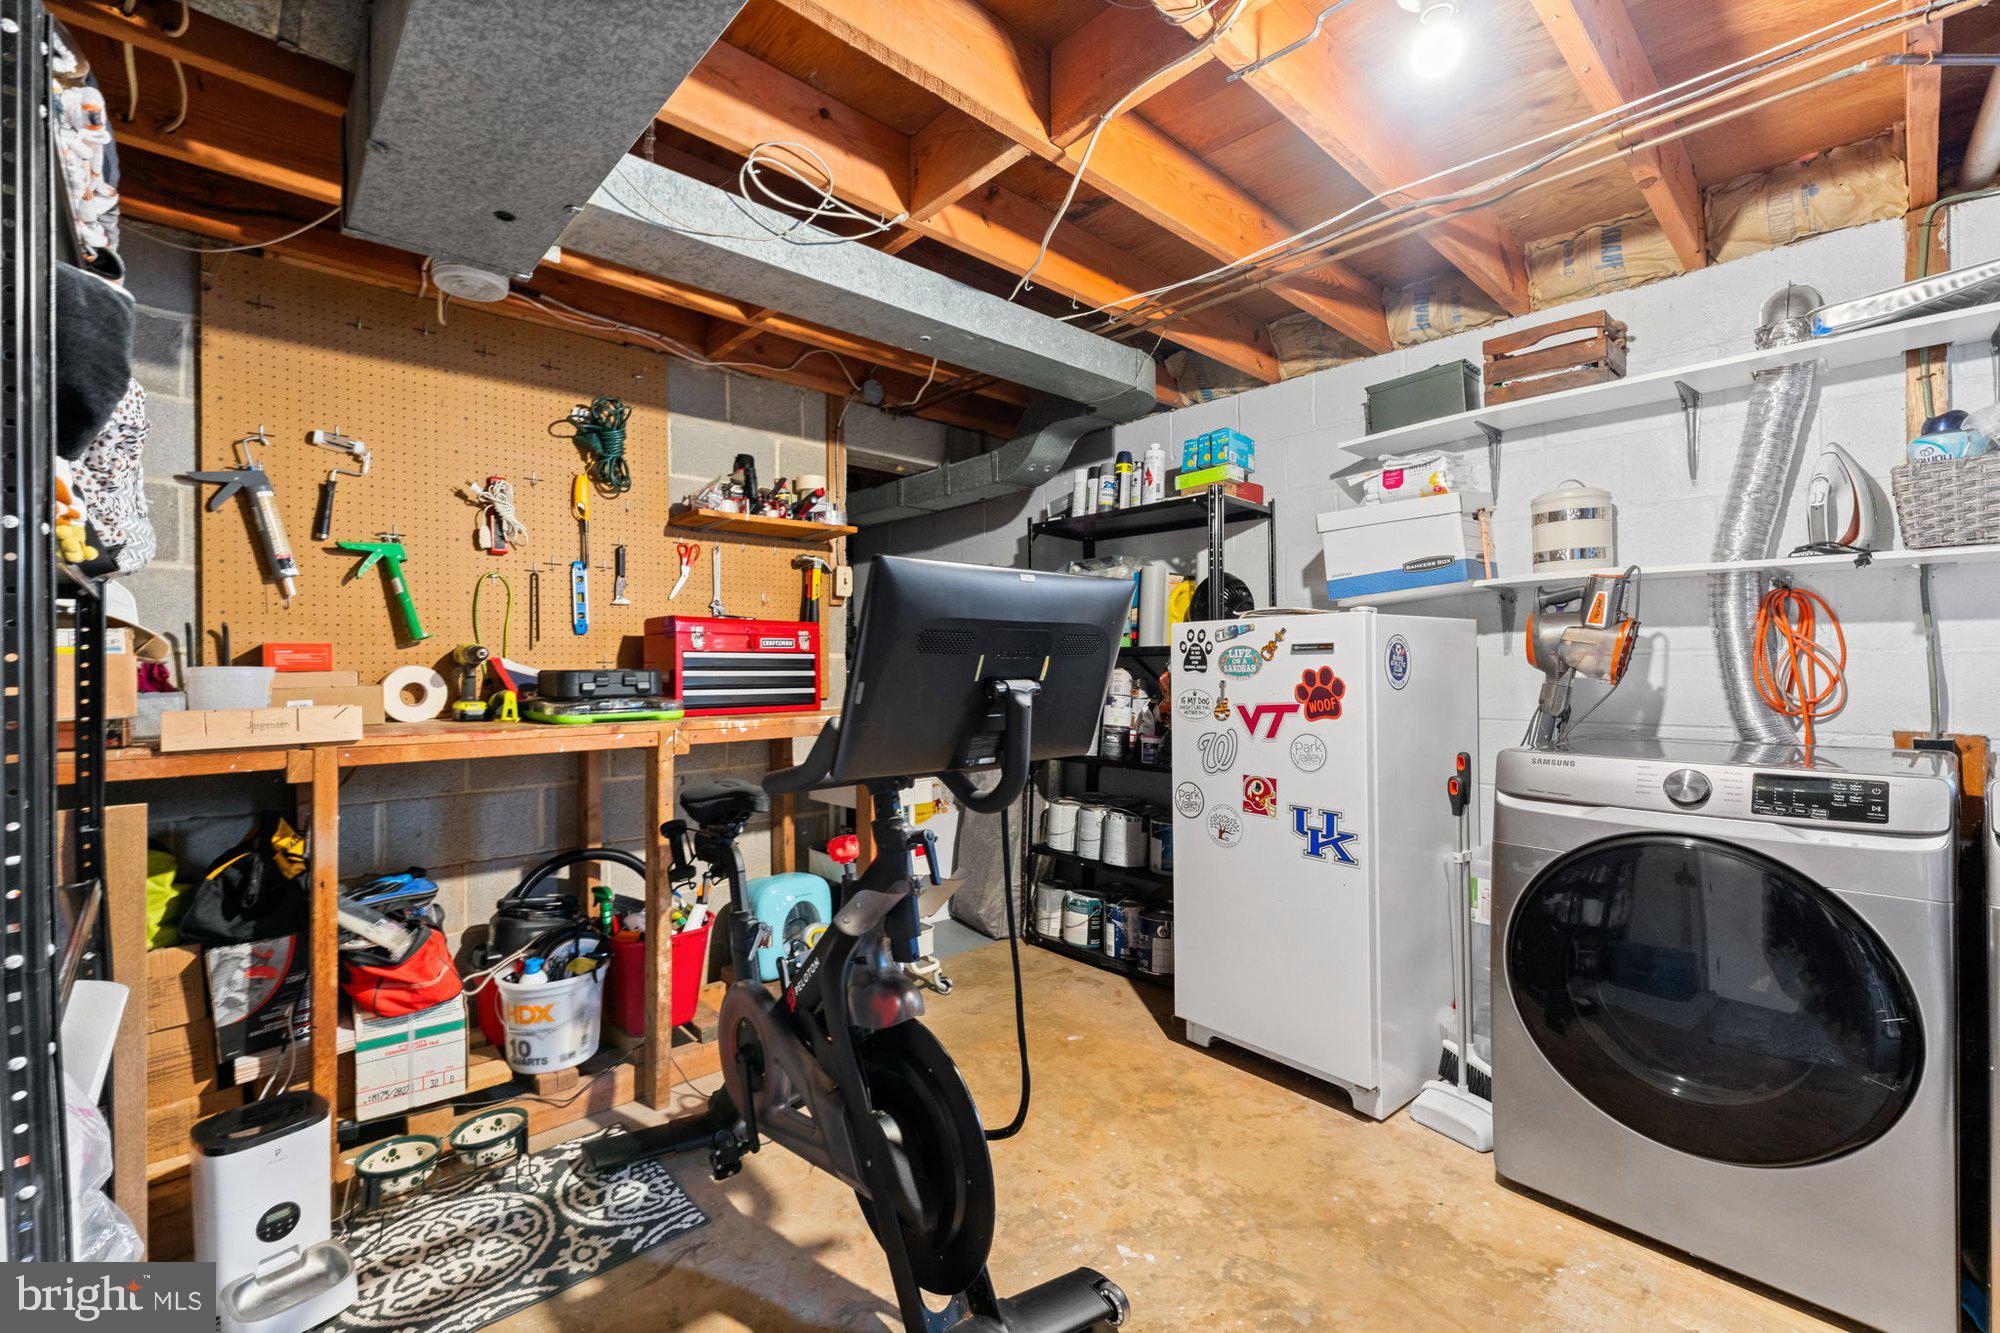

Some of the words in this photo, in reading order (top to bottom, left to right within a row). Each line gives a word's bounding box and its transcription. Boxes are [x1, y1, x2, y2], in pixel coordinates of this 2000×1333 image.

[1405, 561, 1436, 570] BANKERS
[1437, 558, 1451, 566] BOX
[1229, 649, 1252, 657] LIFE
[1223, 665, 1256, 673] SANDBAR
[1187, 697, 1197, 705] MY
[1198, 697, 1210, 705] DOG
[1308, 697, 1337, 713] WOOF
[1237, 704, 1300, 738] VT
[1295, 739, 1323, 754] Park
[1292, 751, 1324, 765] Valley
[1531, 757, 1576, 767] SAMSUNG
[1178, 788, 1200, 803] Park
[1176, 799, 1201, 812] Valley
[1289, 804, 1359, 866] UK
[793, 957, 820, 996] PELOTON
[506, 1003, 555, 1025] HDX
[510, 1039, 532, 1058] 10
